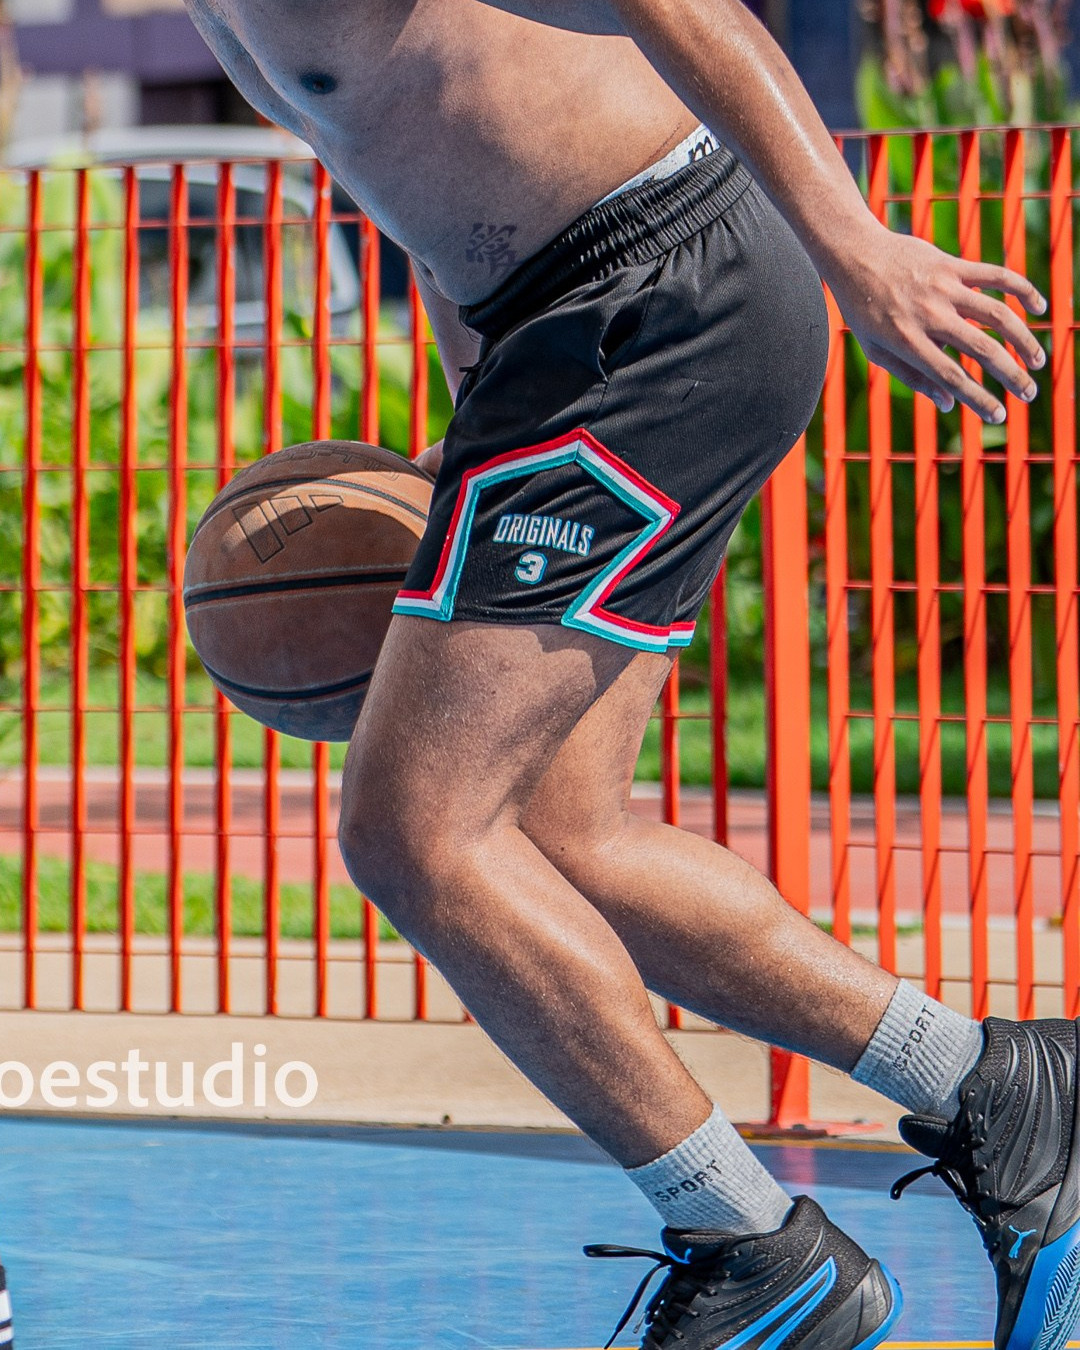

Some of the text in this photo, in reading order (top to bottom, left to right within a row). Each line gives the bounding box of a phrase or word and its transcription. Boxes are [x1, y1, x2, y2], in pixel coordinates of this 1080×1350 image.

[493, 513, 595, 557] ORIGINALS
[514, 550, 548, 585] 3
[893, 1004, 935, 1072] SPORT
[654, 1159, 722, 1203] SPORT
